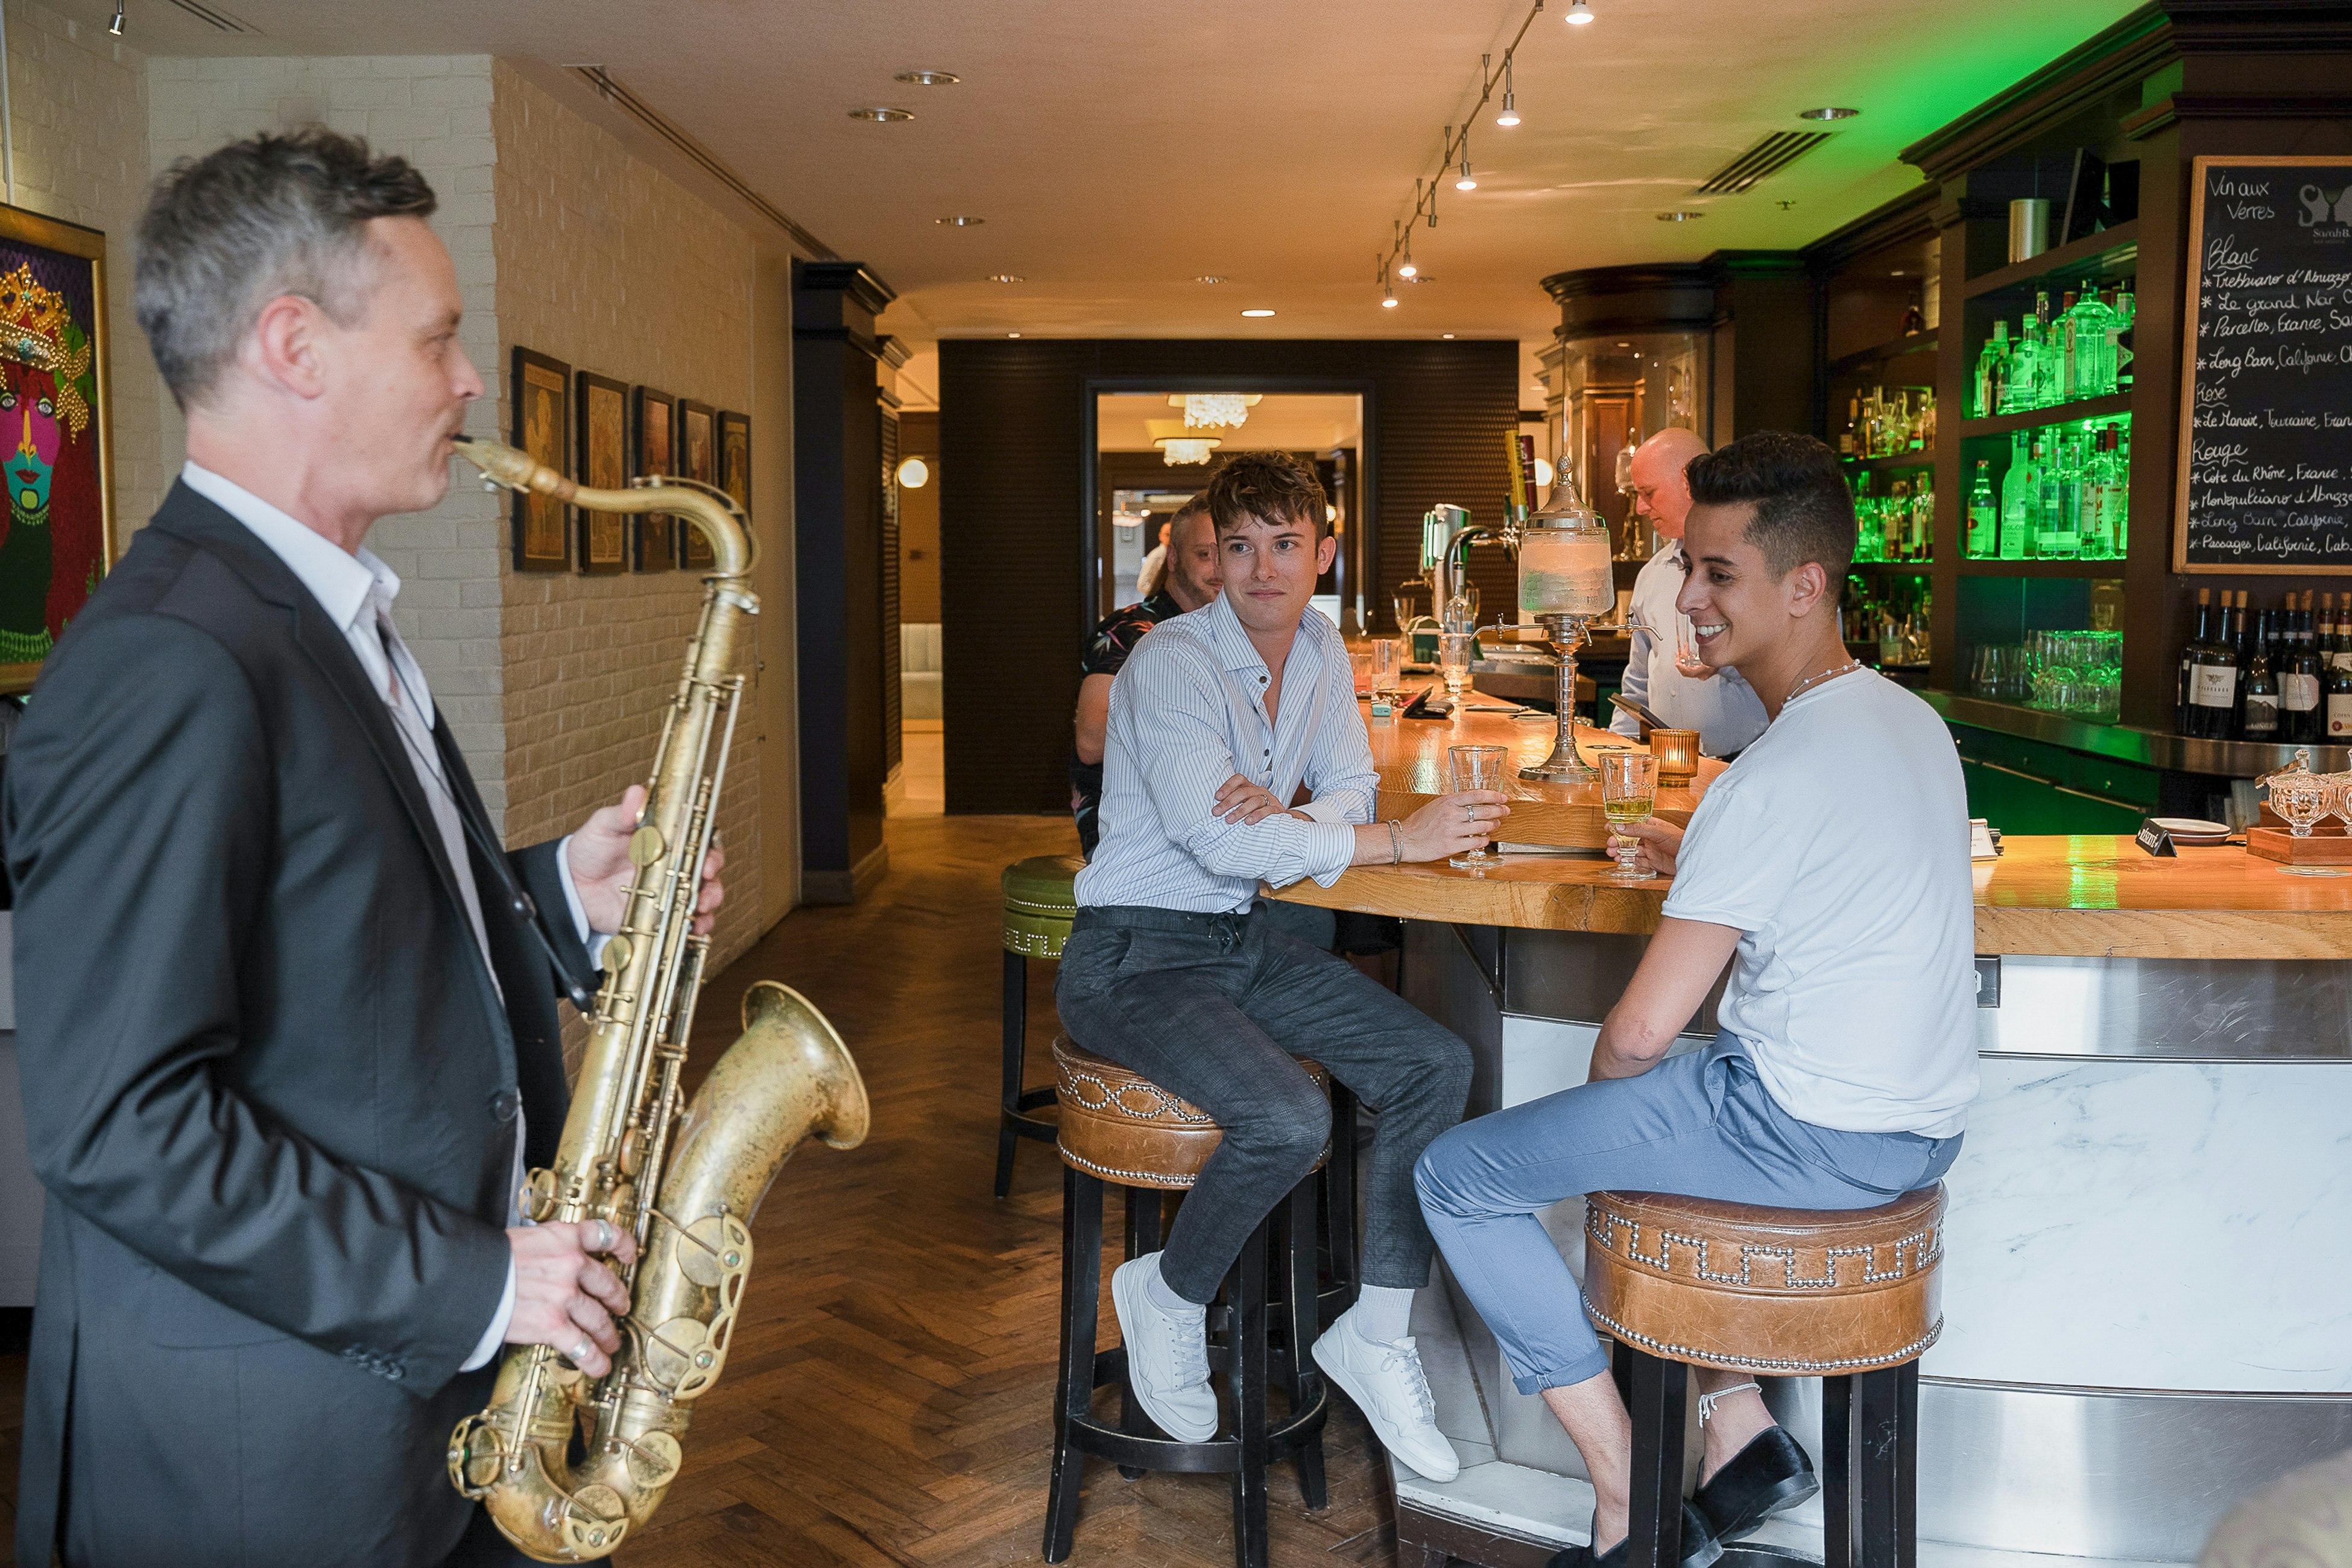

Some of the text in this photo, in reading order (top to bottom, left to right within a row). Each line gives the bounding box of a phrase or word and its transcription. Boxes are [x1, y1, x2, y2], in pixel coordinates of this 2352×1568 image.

[2239, 182, 2269, 197] aux
[2227, 200, 2275, 220] Verres
[2207, 233, 2259, 271] Blanc
[2218, 292, 2242, 311] Le
[2246, 299, 2300, 317] grand
[2208, 346, 2242, 378] Long
[2196, 376, 2227, 404] Rosé
[2192, 437, 2248, 467] Rouge
[2232, 469, 2250, 482] du
[2201, 511, 2238, 534] Long
